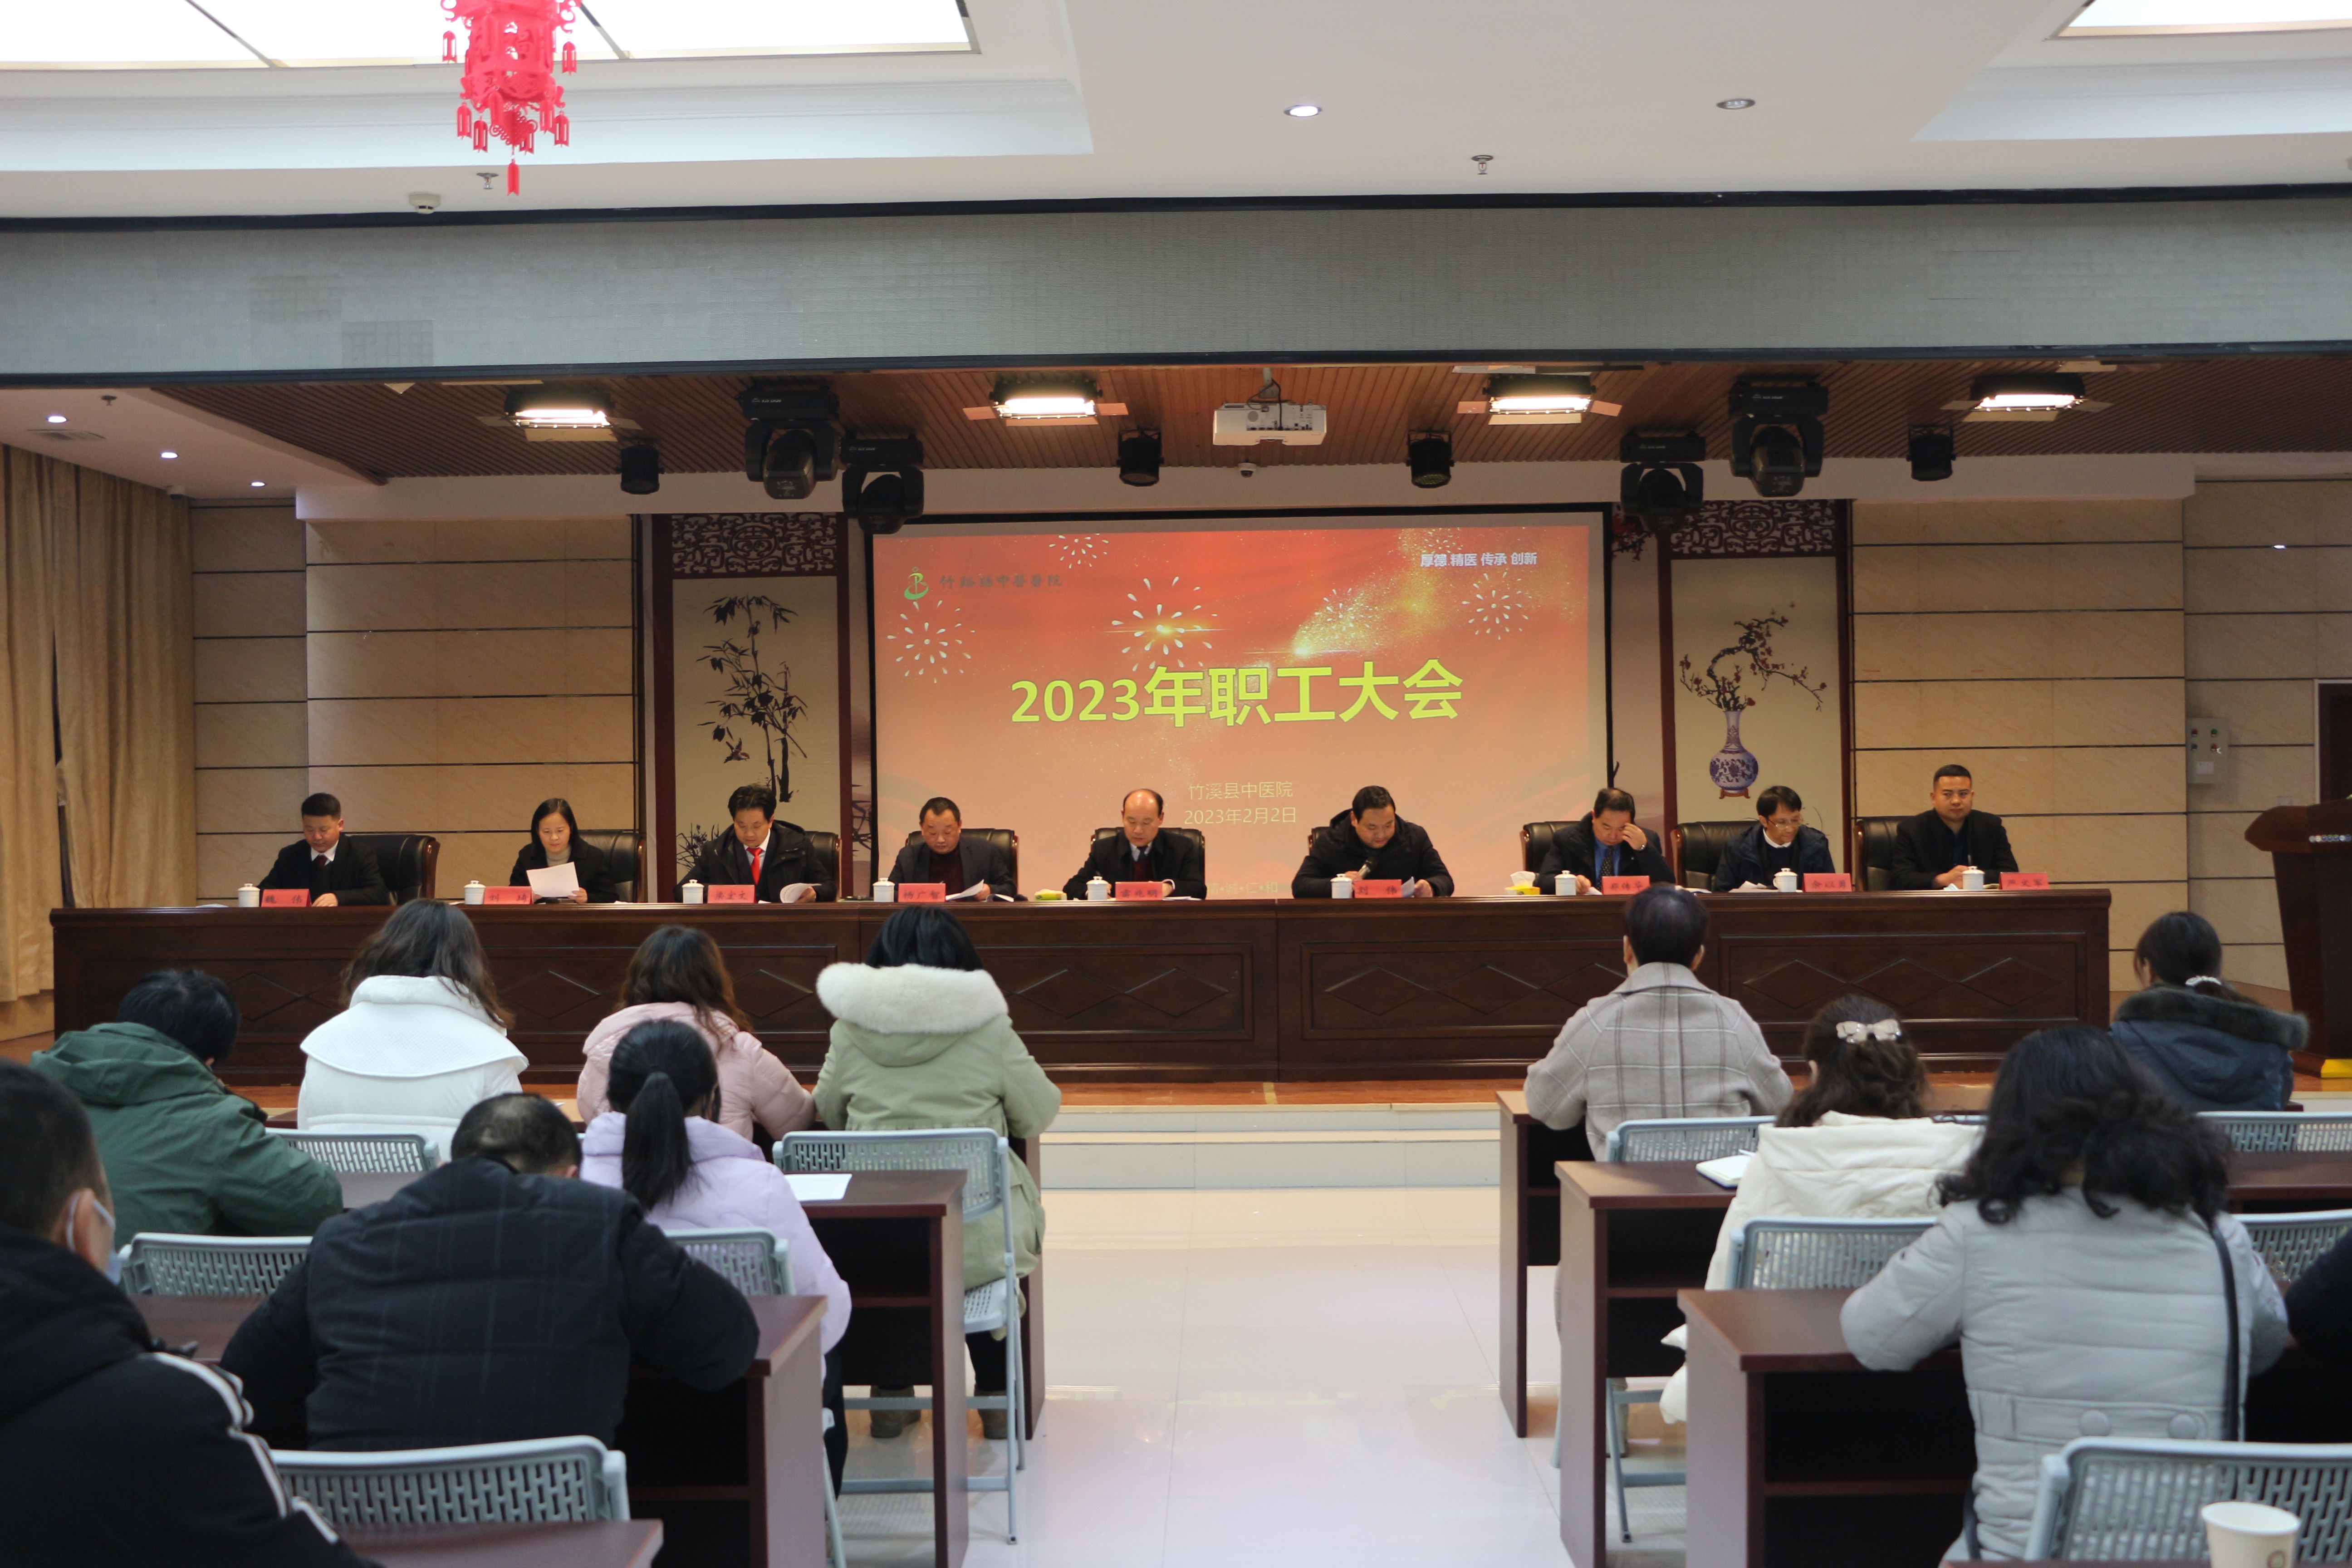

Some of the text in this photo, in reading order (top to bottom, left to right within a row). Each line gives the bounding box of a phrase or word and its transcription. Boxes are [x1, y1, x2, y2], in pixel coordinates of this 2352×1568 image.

[1421, 552, 1538, 567] 厚德 精医 传承 创新
[1010, 658, 1464, 727] 2023年职工大会
[1187, 781, 1293, 800] 竹溪县中医院
[1184, 807, 1296, 825] 2023年2月2日
